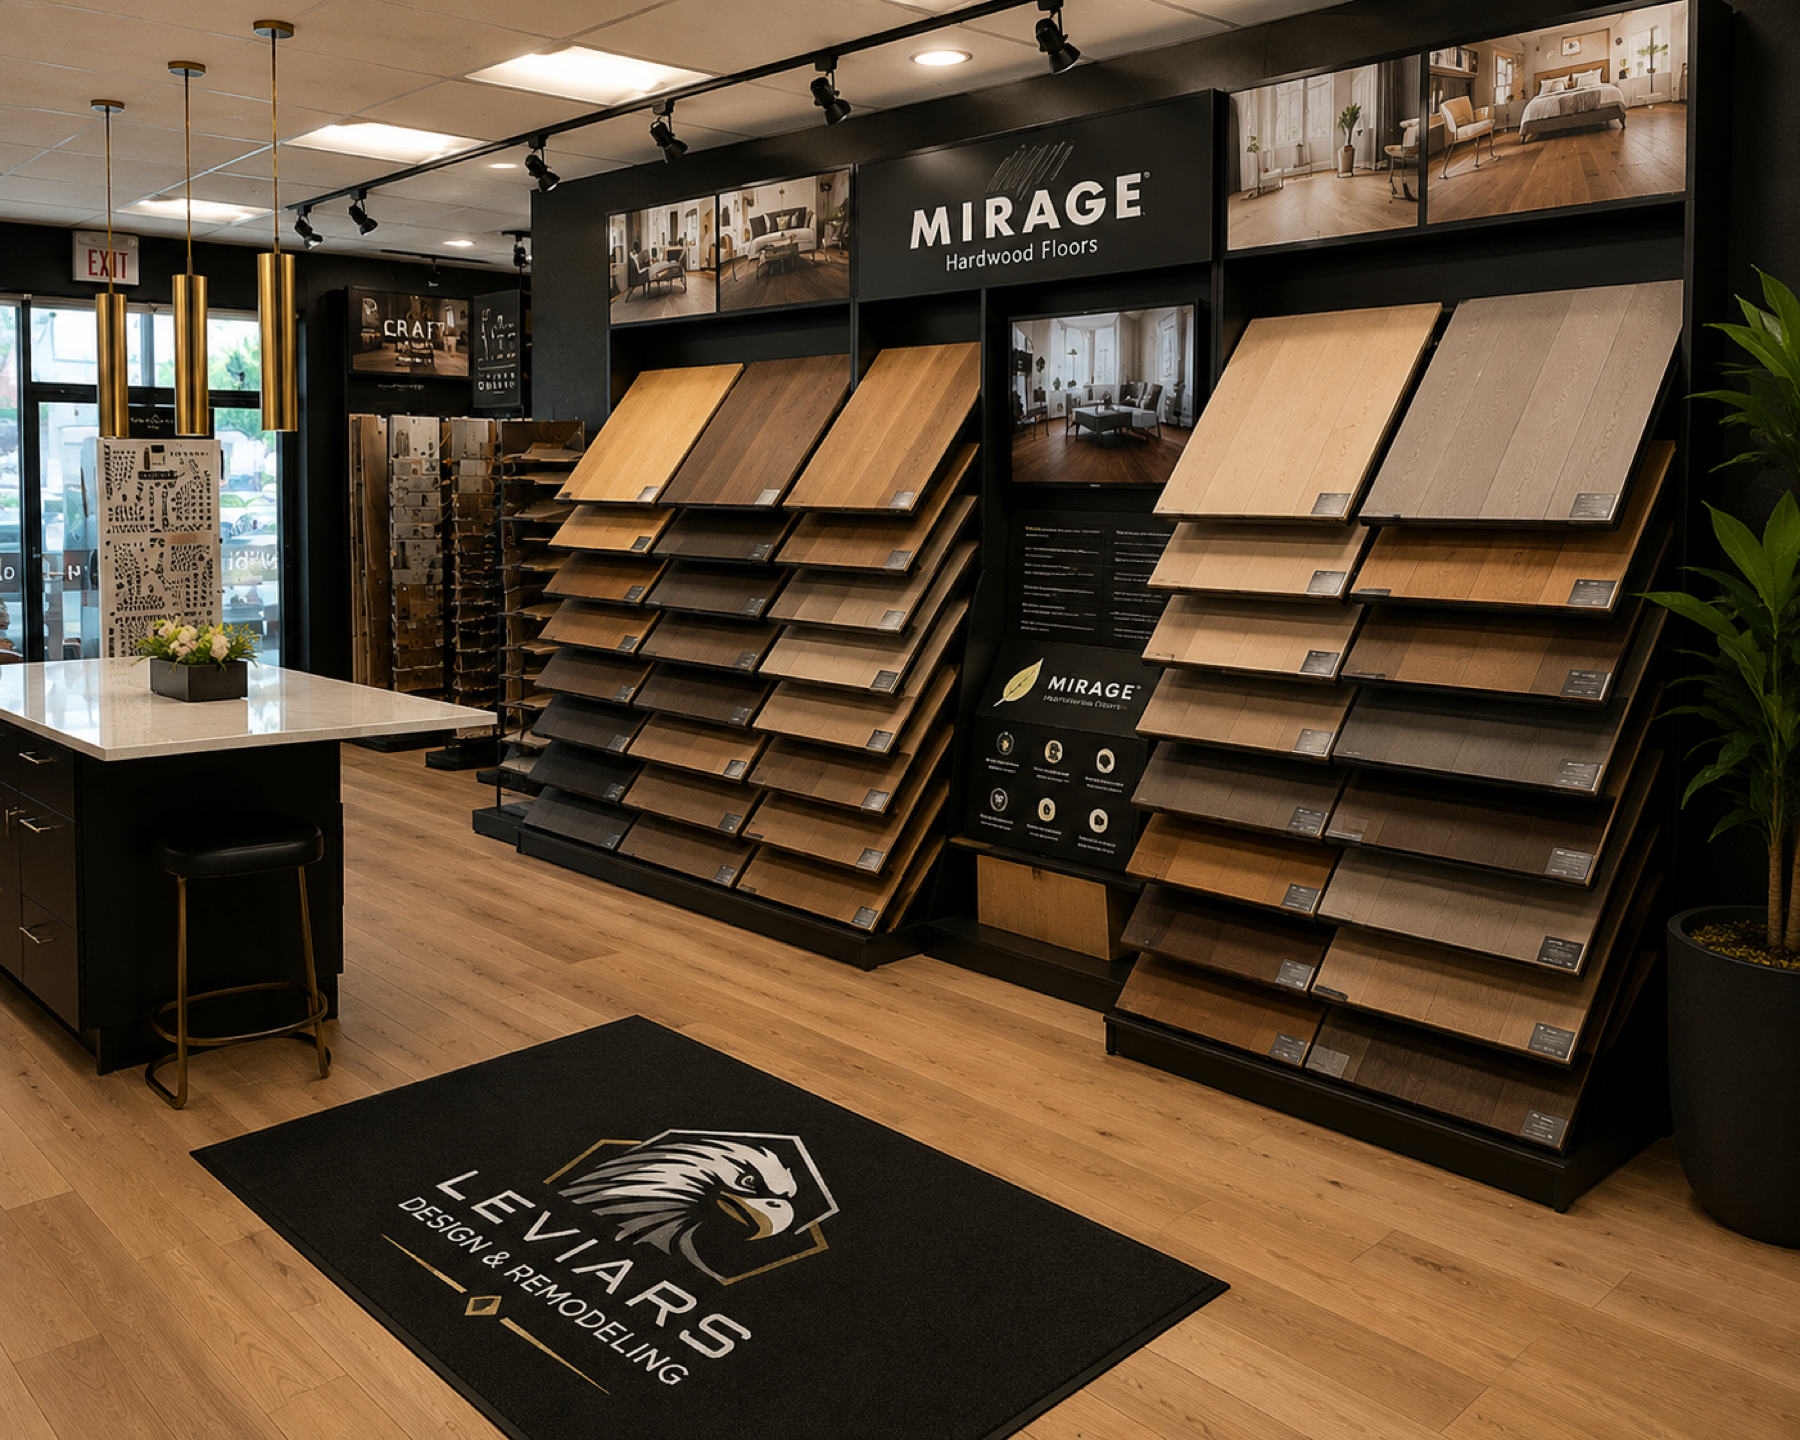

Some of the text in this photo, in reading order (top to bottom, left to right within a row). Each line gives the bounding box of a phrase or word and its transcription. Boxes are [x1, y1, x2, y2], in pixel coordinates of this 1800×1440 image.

[909, 173, 1141, 249] MIRAGE
[88, 249, 128, 279] EXIT
[945, 238, 1098, 272] Hardwood Floors
[1047, 675, 1136, 701] MIRAGE
[397, 1196, 689, 1387] DESIGN & REMODELING
[435, 1169, 752, 1359] LEVIARS
